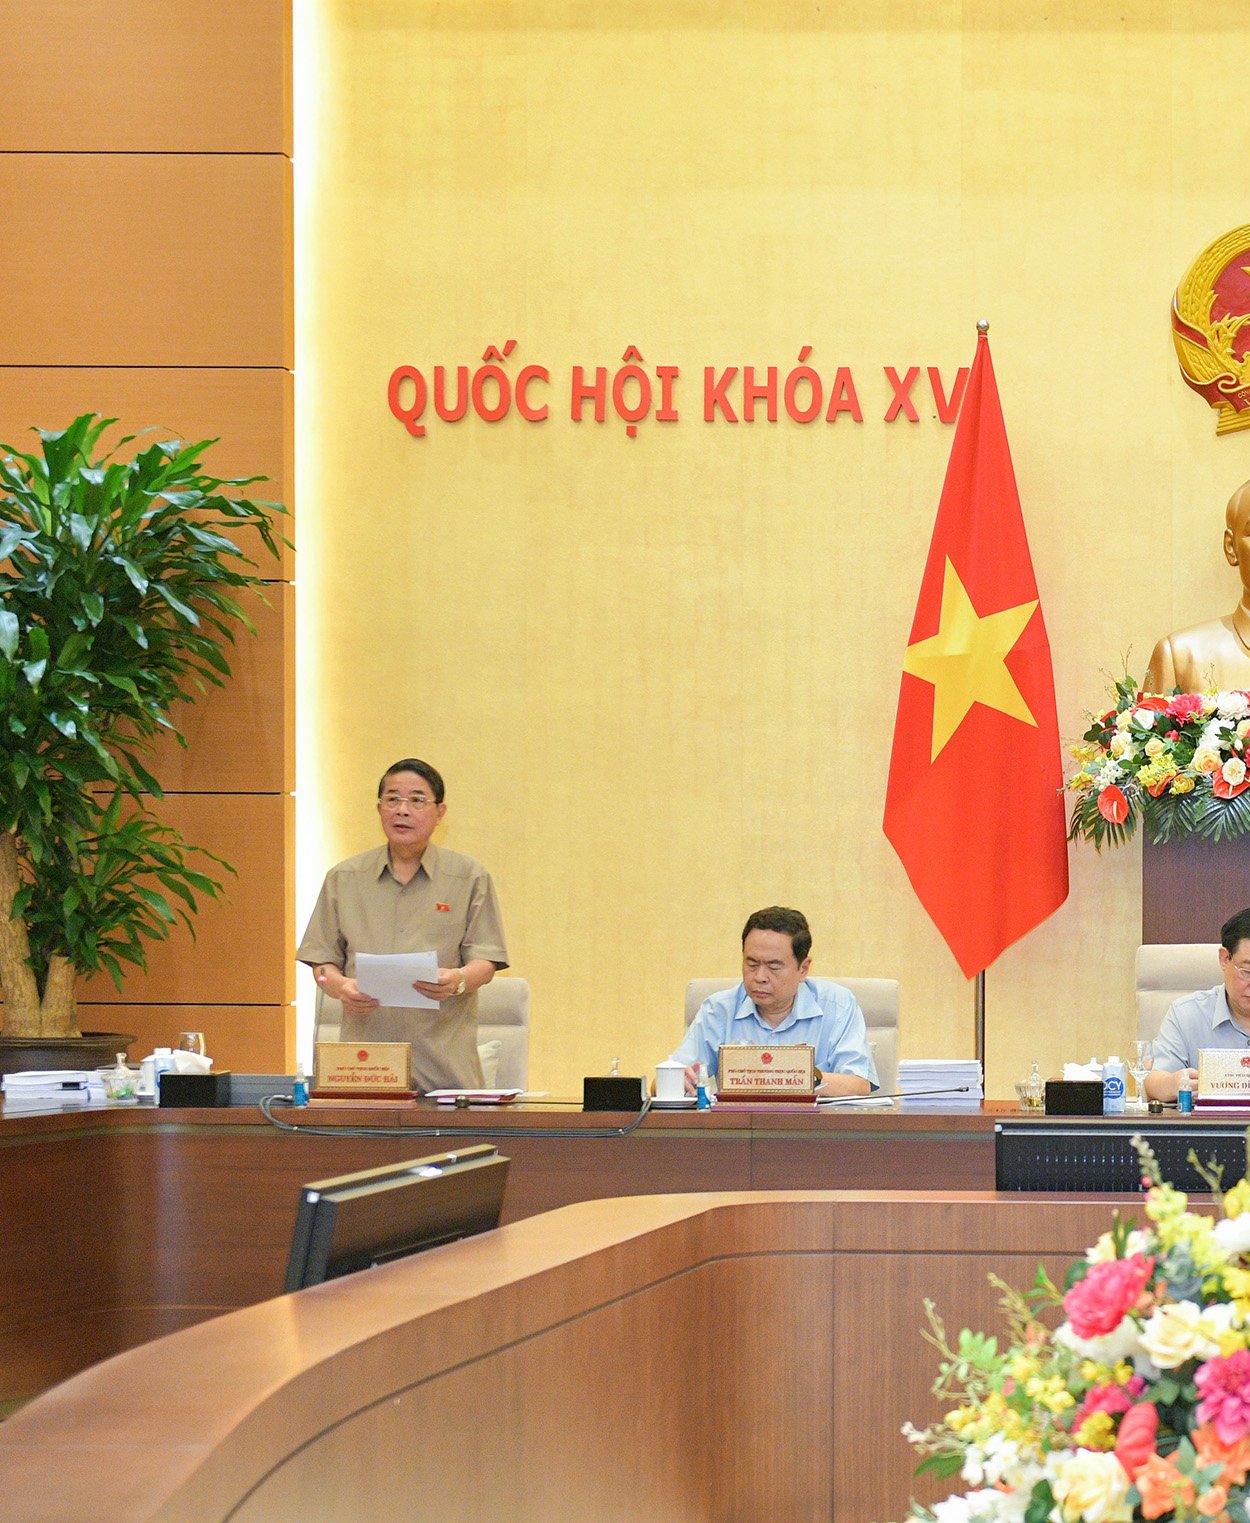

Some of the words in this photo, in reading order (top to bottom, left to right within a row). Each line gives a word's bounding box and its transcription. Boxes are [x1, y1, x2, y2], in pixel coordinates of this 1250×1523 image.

[388, 339, 550, 437] QUỐC
[570, 345, 680, 437] HỘI
[703, 345, 863, 424] KHÓA
[882, 366, 971, 424] XV
